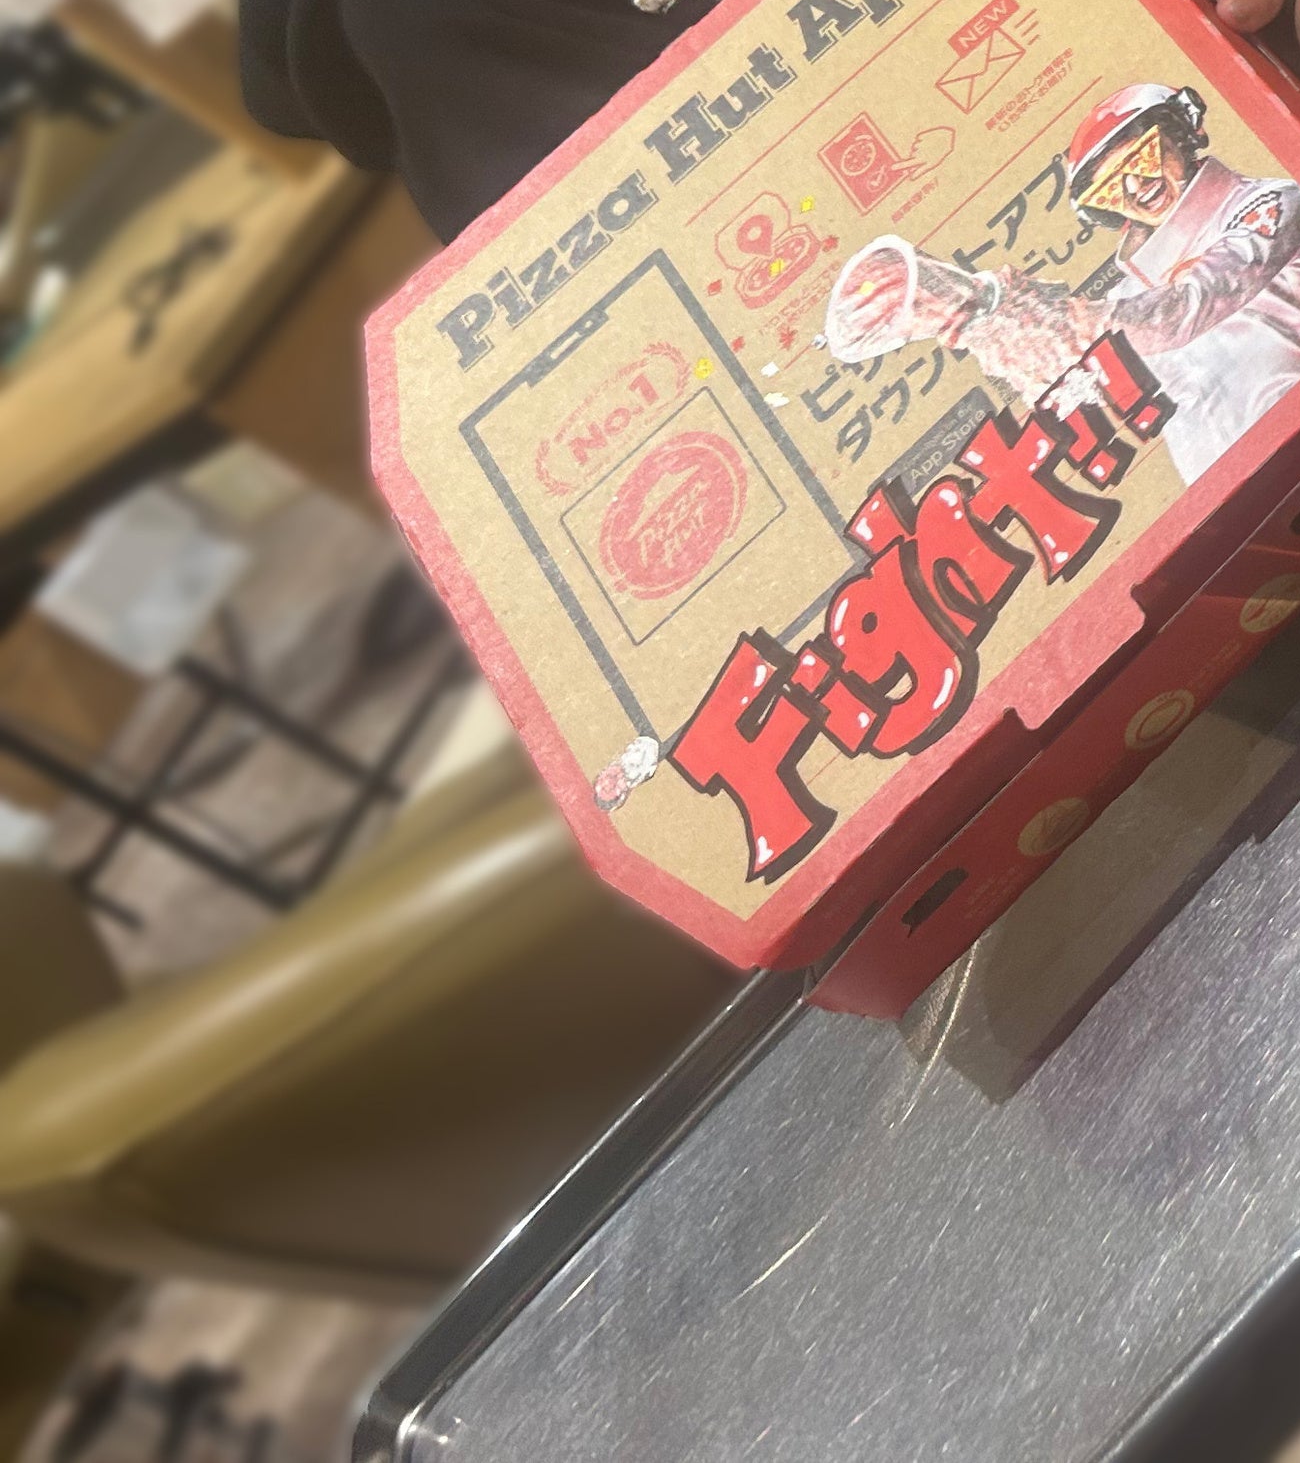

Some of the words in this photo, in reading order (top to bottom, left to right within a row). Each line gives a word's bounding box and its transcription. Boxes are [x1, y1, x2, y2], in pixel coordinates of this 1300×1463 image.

[435, 168, 660, 373] Pizza
[643, 42, 797, 185] Hut
[566, 373, 661, 466] No.1
[907, 448, 949, 485] App
[940, 407, 990, 453] Store
